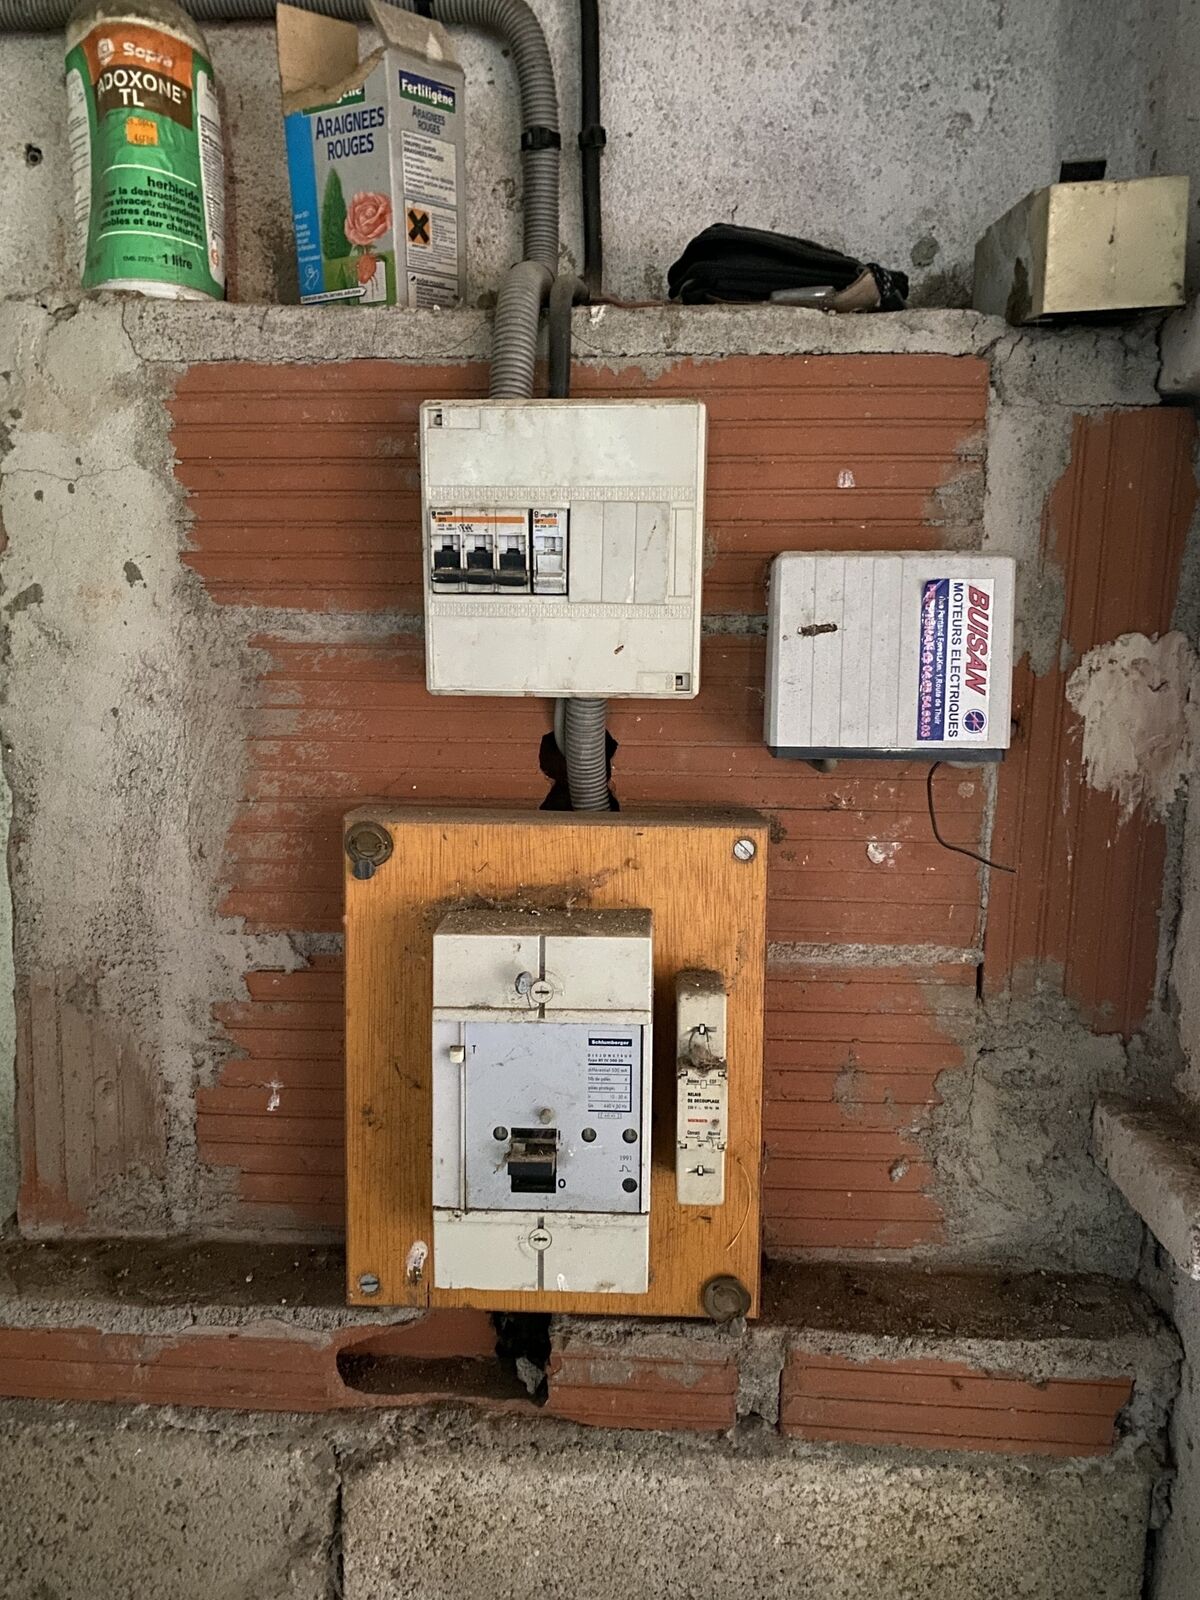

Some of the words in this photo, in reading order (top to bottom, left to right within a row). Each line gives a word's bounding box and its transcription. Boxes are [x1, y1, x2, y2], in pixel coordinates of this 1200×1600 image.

[122, 41, 173, 68] Sopra
[119, 88, 145, 108] TL
[401, 78, 454, 107] Fertiligène
[316, 106, 385, 141] ARAIGNEES
[412, 105, 446, 126] ARAIGNEES
[417, 118, 441, 135] ROUGES
[327, 132, 375, 161] ROUGES
[118, 186, 128, 195] la
[131, 186, 186, 206] destruction
[147, 175, 200, 204] herbicide
[143, 207, 168, 220] dans
[147, 219, 164, 228] sur
[162, 253, 168, 265] 1
[172, 253, 193, 270] litre
[952, 582, 964, 645] MOTEURS
[965, 584, 990, 696] BUISAN
[935, 699, 942, 707] de
[948, 649, 962, 738] ELECTRIQUES
[934, 708, 942, 725] Thuir
[471, 1044, 477, 1054] T
